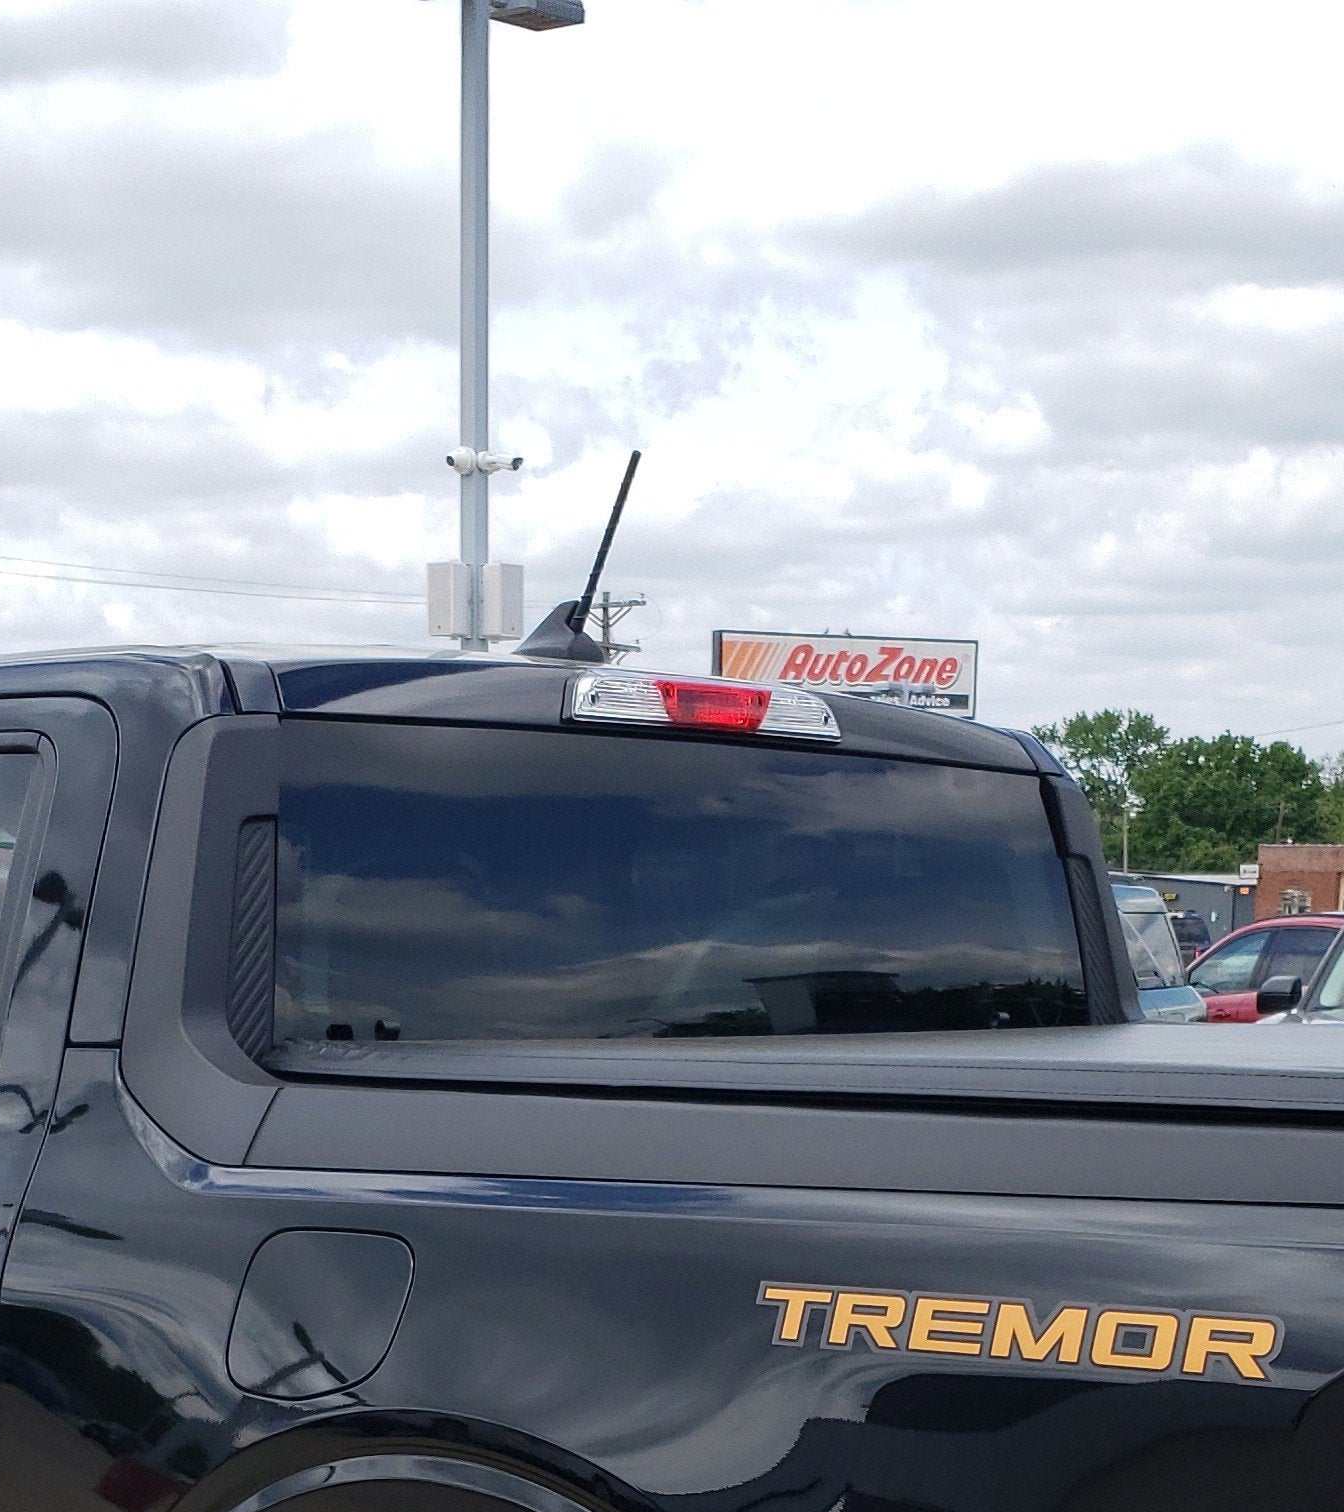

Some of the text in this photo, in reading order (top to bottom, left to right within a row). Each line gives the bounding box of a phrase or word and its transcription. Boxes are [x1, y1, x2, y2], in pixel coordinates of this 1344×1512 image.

[777, 643, 959, 687] AutoZone
[909, 694, 951, 707] Advice
[763, 1286, 1276, 1380] TREMOR
